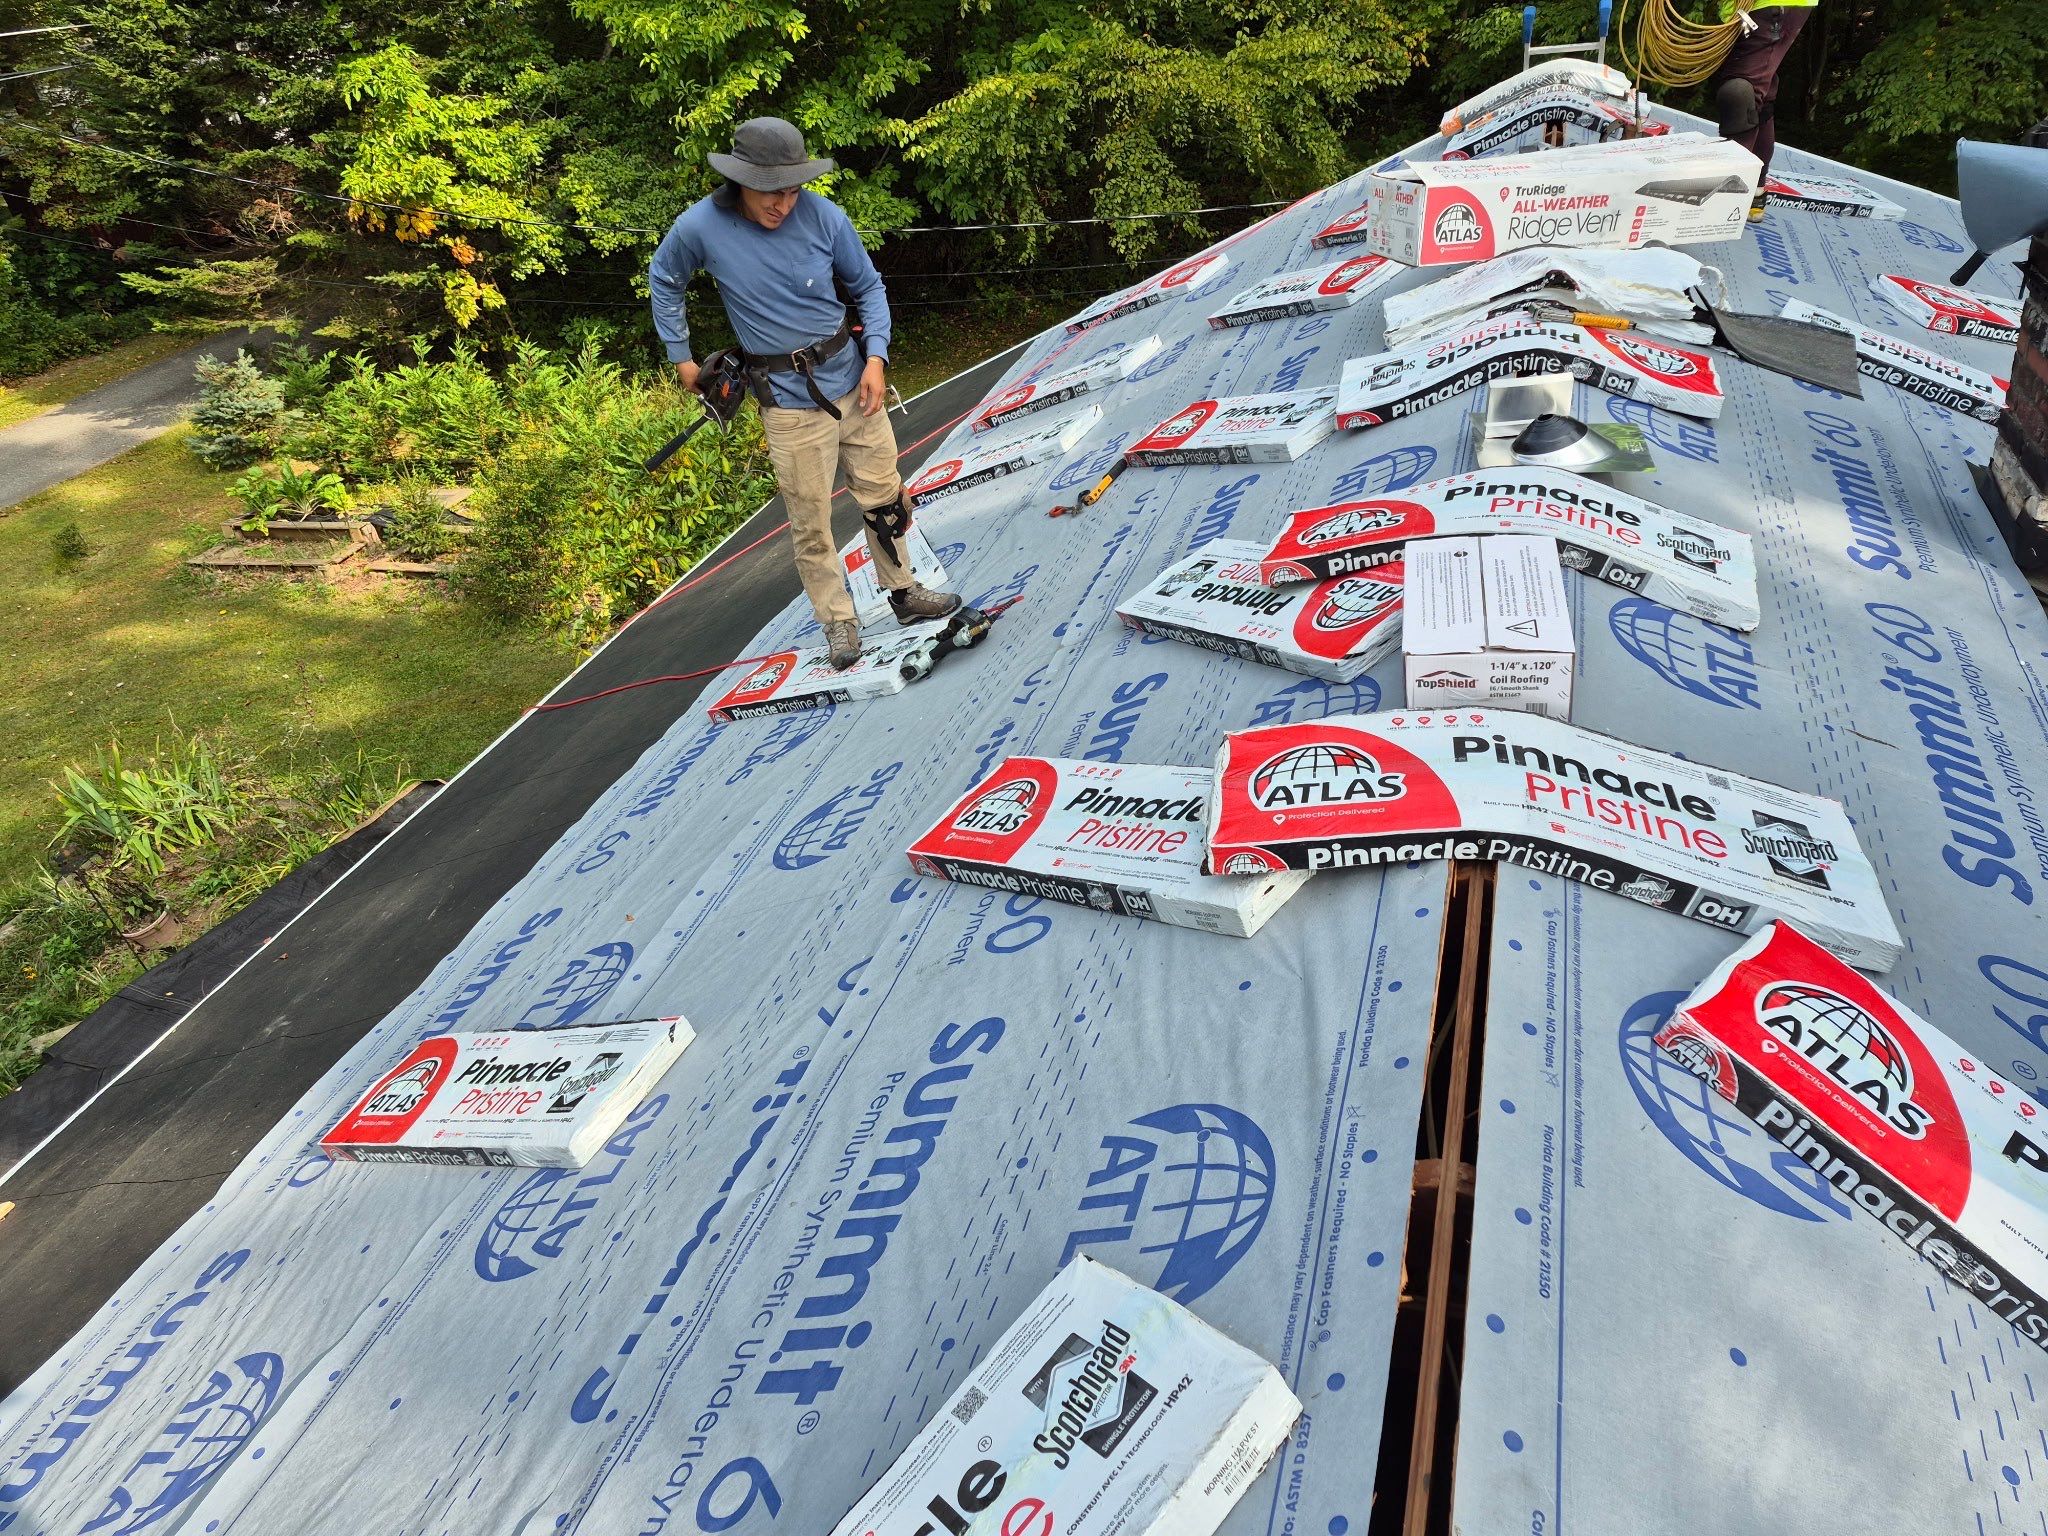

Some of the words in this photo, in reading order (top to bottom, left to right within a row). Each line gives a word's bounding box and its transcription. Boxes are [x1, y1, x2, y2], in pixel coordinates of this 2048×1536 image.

[1473, 118, 1530, 154] Pinnacle
[1531, 108, 1575, 126] Pristine
[1512, 195, 1609, 214] ALL-WEATHER
[1516, 184, 1565, 197] TruRidge
[1766, 194, 1808, 210] Pinnacle
[1808, 198, 1840, 215] Pristine
[1508, 215, 1572, 243] Ridge
[1576, 209, 1622, 234] Vent
[1859, 208, 1870, 217] OH
[1438, 226, 1483, 243] ATLAS
[1112, 304, 1136, 319] Pristine
[1226, 311, 1260, 327] Pinnacle
[1260, 306, 1286, 320] Pristine
[1303, 303, 1313, 312] OH
[1962, 320, 2020, 343] Pinnacle
[1426, 327, 1583, 370] Pinnacle
[1606, 334, 1688, 368] ATLAS
[1359, 361, 1416, 390] Scotchgard
[1860, 337, 1993, 394] Pinnacle
[1076, 383, 1086, 392] OH
[1392, 371, 1484, 419] Pinnacle
[1487, 348, 1562, 381] Pristine
[1606, 375, 1631, 392] OH
[1903, 374, 1973, 412] Pristine
[991, 406, 1028, 427] Pinnacle
[1028, 395, 1059, 411] Pristine
[1215, 417, 1275, 432] Pristine
[1216, 402, 1296, 419] Pinnacle
[1803, 410, 1862, 448] 60
[1012, 459, 1024, 469] OH
[1145, 453, 1184, 465] Pinnacle
[1185, 451, 1217, 463] Pristine
[1237, 448, 1247, 457] OH
[917, 484, 959, 504] Pinnacle
[959, 470, 993, 490] Pristine
[1444, 482, 1641, 526] Pinnacle
[1811, 446, 1912, 580] Summit
[1307, 514, 1401, 543] ATLAS
[1490, 497, 1642, 545] Pristine
[1657, 533, 1731, 562] Scotchgard
[1609, 569, 1640, 588] OH
[1191, 583, 1296, 618] Pinnacle
[1144, 622, 1194, 645] Pinnacle
[1193, 635, 1237, 657] Pristine
[1864, 602, 1943, 663] 60
[1263, 651, 1280, 665] OH
[836, 692, 849, 701] OH
[1416, 679, 1476, 689] TopShield
[1490, 675, 1509, 684] Coil
[1511, 675, 1549, 685] Roofing
[732, 704, 778, 720] Pinnacle
[777, 697, 815, 713] Pristine
[1453, 735, 1717, 822] Pinnacle
[1984, 726, 2035, 802] Synthetic
[1264, 775, 1401, 808] ATLAS
[1879, 666, 2034, 906] Summit
[821, 763, 900, 851] ATLAS
[958, 810, 1028, 832] ATLAS
[1289, 810, 1336, 820] Protection
[1338, 807, 1385, 815] Delivered
[1521, 804, 1548, 814] HP42
[1525, 772, 1728, 859] Pristine
[1066, 818, 1188, 854] Pristine
[1741, 828, 1839, 864] Scotchgard
[1307, 838, 1478, 869] Pinnacle
[1488, 839, 1616, 891] Pristine
[946, 864, 1020, 892] Pinnacle
[1021, 875, 1086, 906] Pristine
[1621, 882, 1675, 901] Scotchgard
[1129, 894, 1149, 910] OH
[1700, 901, 1743, 925] OH
[1376, 945, 1388, 968] 21350
[1547, 932, 1557, 970] Fastners
[1832, 943, 1861, 956] HARVEST
[1371, 975, 1383, 1001] Code
[1547, 971, 1556, 1010] Required
[1365, 998, 1380, 1034] Building
[1332, 1047, 1346, 1065] being
[1359, 1035, 1373, 1067] Florida
[1545, 1035, 1556, 1068] Staples
[453, 1056, 572, 1085] Pinnacle
[1325, 1064, 1338, 1097] footwear
[1669, 1048, 1723, 1090] ATLAS
[1764, 1014, 1928, 1135] ATLAS
[1949, 1061, 1977, 1083] LIFETIME
[368, 1092, 422, 1112] ATLAS
[450, 1086, 543, 1115] Pristine
[1778, 1052, 1838, 1097] Protection
[1833, 1092, 1887, 1138] Delivered
[829, 1070, 907, 1183] Premium
[1320, 1103, 1332, 1143] conditions
[1344, 1122, 1359, 1155] Staples
[414, 1151, 466, 1166] Pristine
[1315, 1143, 1325, 1171] surface
[1543, 1125, 1554, 1162] Florida
[531, 1092, 670, 1259] ATLAS
[1340, 1156, 1350, 1179] NO
[751, 1192, 765, 1210] Cap
[1309, 1172, 1321, 1206] weather,
[1538, 1164, 1554, 1212] Building
[753, 1017, 1006, 1405] Summit
[1307, 1206, 1315, 1221] on
[1329, 1187, 1346, 1242] Required
[729, 1211, 755, 1247] Fastners
[1540, 1215, 1552, 1247] Code
[2000, 1219, 2022, 1237] BUILT
[2023, 1237, 2044, 1254] WITH
[752, 1189, 843, 1330] Synthetic
[1298, 1222, 1312, 1270] dependent
[705, 1248, 732, 1291] Required
[1294, 1270, 1307, 1293] vary
[1322, 1243, 1338, 1299] Fastners
[1539, 1260, 1552, 1299] 21350
[1290, 1294, 1303, 1312] may
[1317, 1298, 1332, 1327] Cap
[665, 1319, 694, 1352] Staples
[1281, 1301, 1297, 1366] resistance
[1118, 1353, 1137, 1374] 3M
[1028, 1377, 1044, 1394] WITH
[1033, 1319, 1131, 1470] Scotchgard
[1091, 1384, 1113, 1419] PROTECTOR
[610, 1415, 638, 1453] Florida
[1101, 1419, 1127, 1453] SHINGLE
[1122, 1388, 1153, 1428] PROTECTOR
[1066, 1488, 1103, 1536] CONSTRUIT
[1102, 1469, 1119, 1492] AVEC
[1118, 1460, 1128, 1471] LA
[1127, 1407, 1168, 1460] TECHNOLOGIE
[1166, 1376, 1194, 1409] HP42
[1204, 1457, 1234, 1497] MORNING
[1231, 1423, 1260, 1460] HARVEST
[1284, 1465, 1303, 1513] ASTM
[1296, 1412, 1313, 1451] 8257
[1113, 1499, 1134, 1521] Select
[1130, 1474, 1152, 1498] System.
[1124, 1506, 1135, 1518] for
[1134, 1488, 1151, 1506] more
[1149, 1462, 1169, 1486] details.
